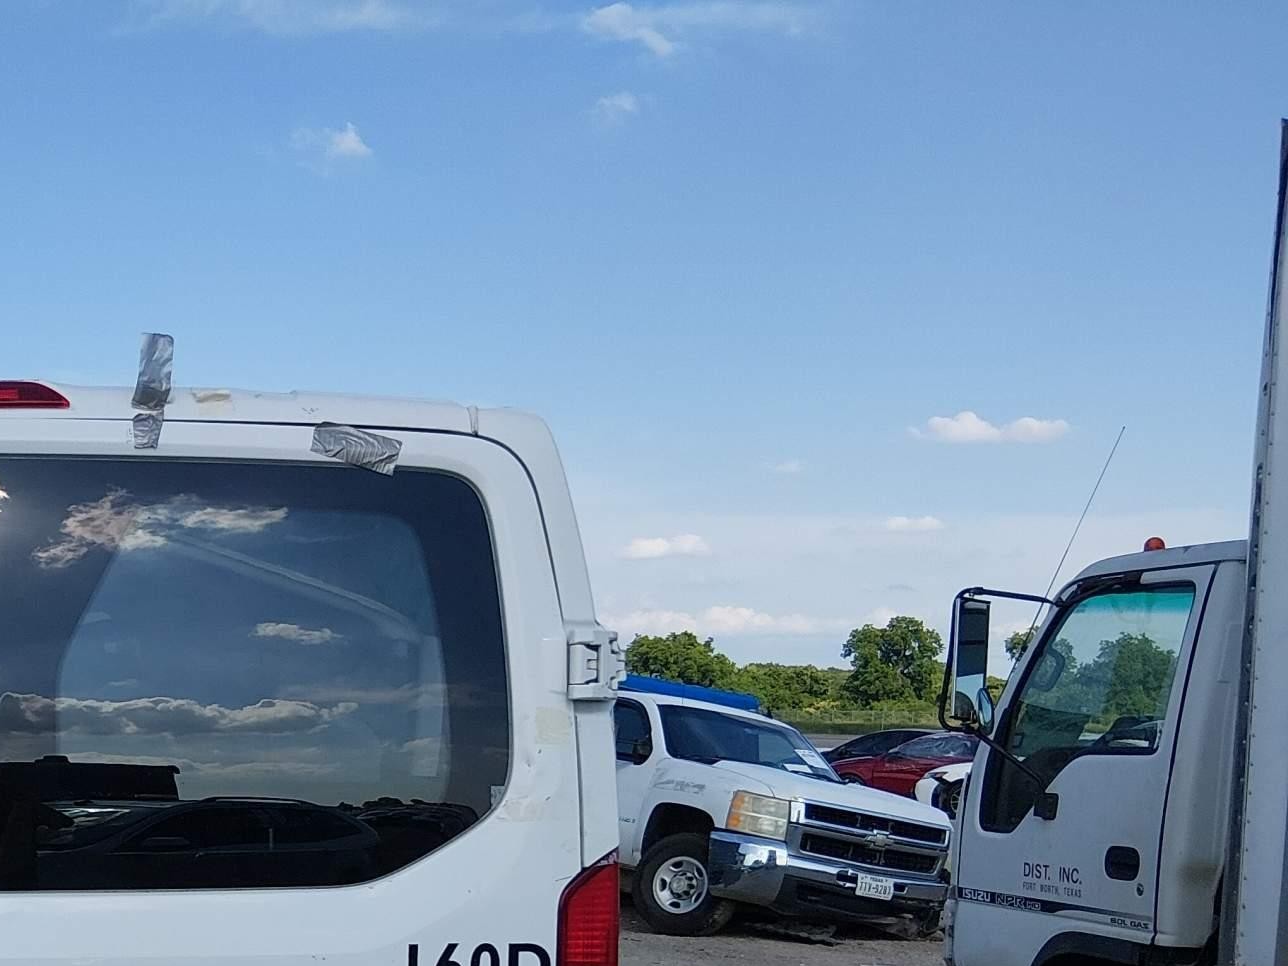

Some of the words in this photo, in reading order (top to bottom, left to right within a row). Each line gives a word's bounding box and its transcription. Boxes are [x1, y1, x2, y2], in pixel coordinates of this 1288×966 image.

[1023, 862, 1051, 880] DIST.
[1059, 866, 1083, 885] INC.
[962, 888, 991, 902] ISUZU
[1022, 881, 1037, 892] FORT
[1063, 886, 1082, 898] TEXAS
